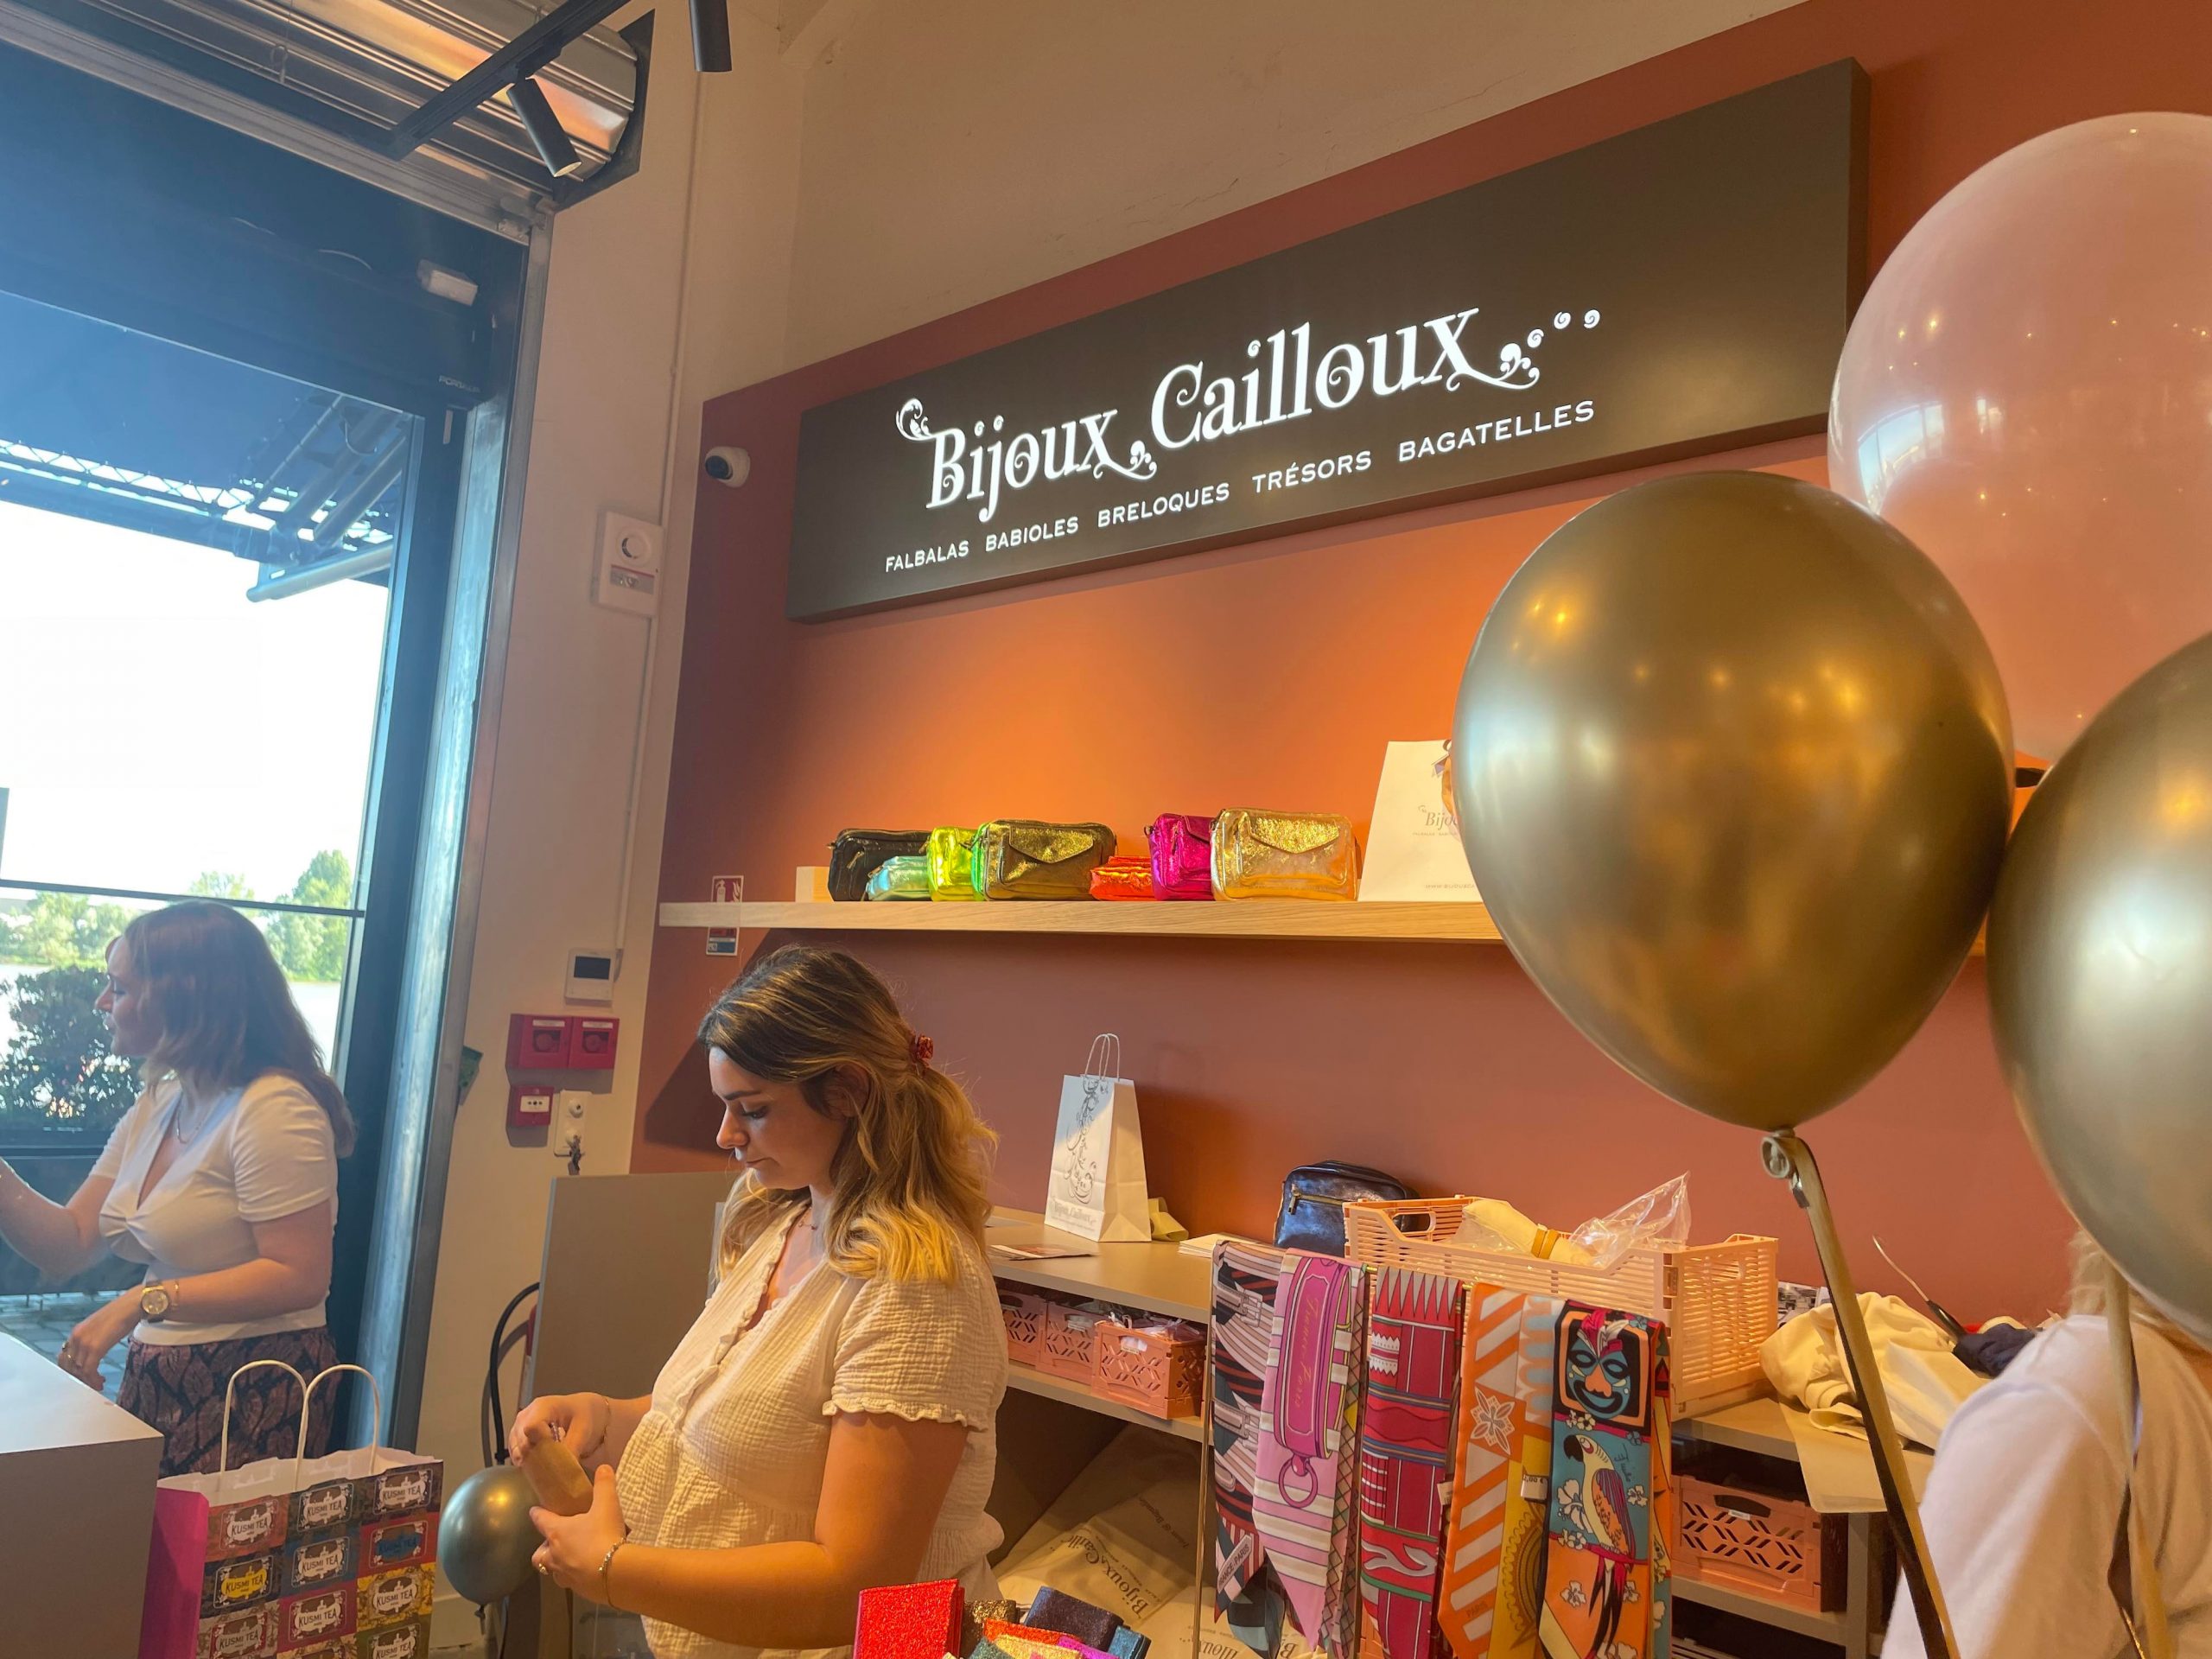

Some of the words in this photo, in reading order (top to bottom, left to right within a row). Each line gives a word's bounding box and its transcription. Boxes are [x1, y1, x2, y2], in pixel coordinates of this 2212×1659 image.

[896, 399, 1157, 523] Bijoux
[1152, 308, 1541, 449] Cailloux
[884, 539, 970, 574] FALBALAS
[984, 516, 1080, 553] BABIOLES
[1096, 481, 1230, 529] BRELOQUES
[1251, 449, 1372, 494] TRÉSORS
[1398, 399, 1595, 463] BAGATELLES
[407, 1484, 421, 1496] TEA
[328, 1499, 343, 1511] TEA
[254, 1517, 269, 1531] TEA
[325, 1554, 339, 1566] TEA
[251, 1573, 264, 1586] TEA
[400, 1588, 414, 1600] TEA
[323, 1607, 337, 1619] TEA
[245, 1629, 258, 1641] TEA
